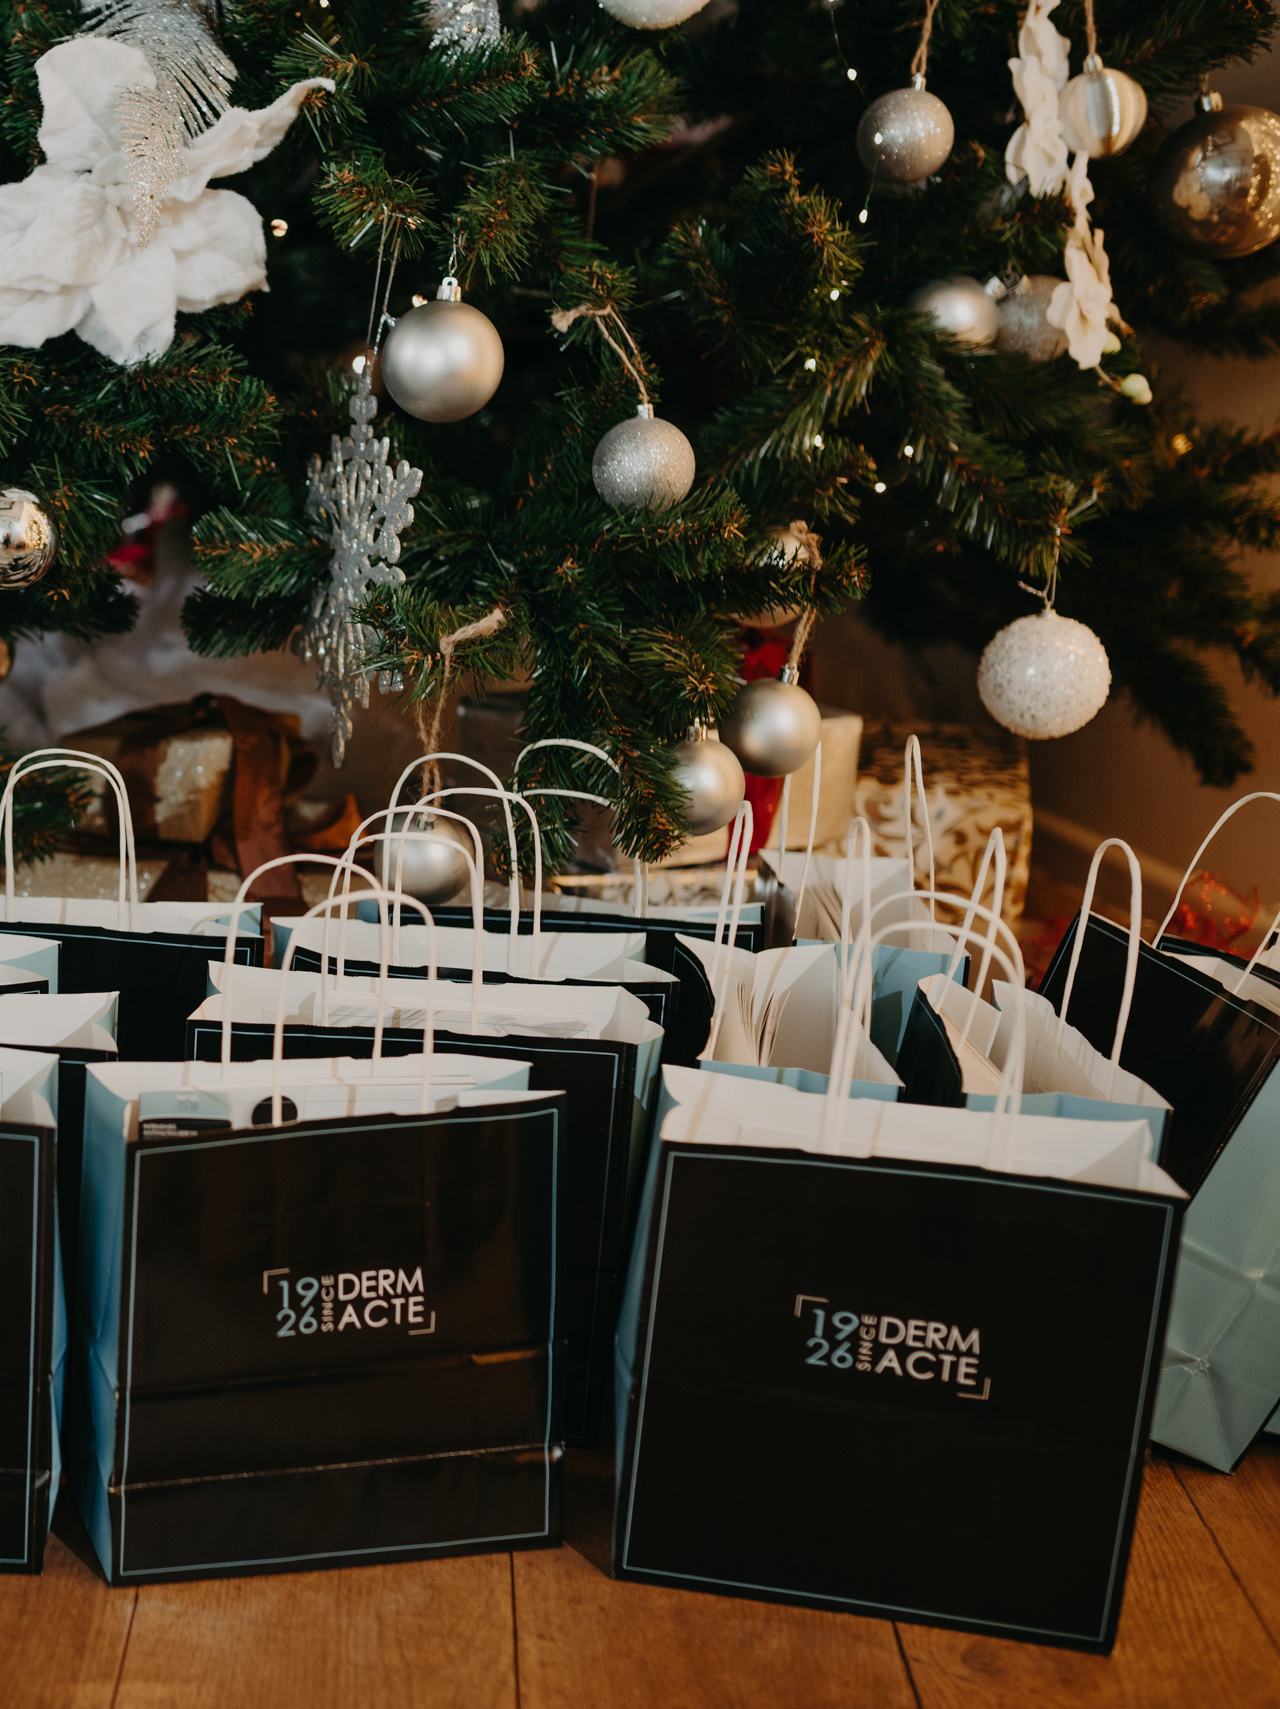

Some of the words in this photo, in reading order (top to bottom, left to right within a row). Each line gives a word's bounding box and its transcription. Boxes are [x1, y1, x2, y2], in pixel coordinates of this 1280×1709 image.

[278, 1276, 320, 1309] 19
[337, 1266, 425, 1302] DERM
[276, 1305, 319, 1338] 26
[320, 1274, 335, 1333] SINCE
[337, 1296, 425, 1332] ACTE
[812, 1308, 860, 1341] 19
[855, 1313, 878, 1372] SINCE
[878, 1315, 981, 1356] DERM
[804, 1336, 854, 1369] 26
[874, 1347, 980, 1386] ACTE
